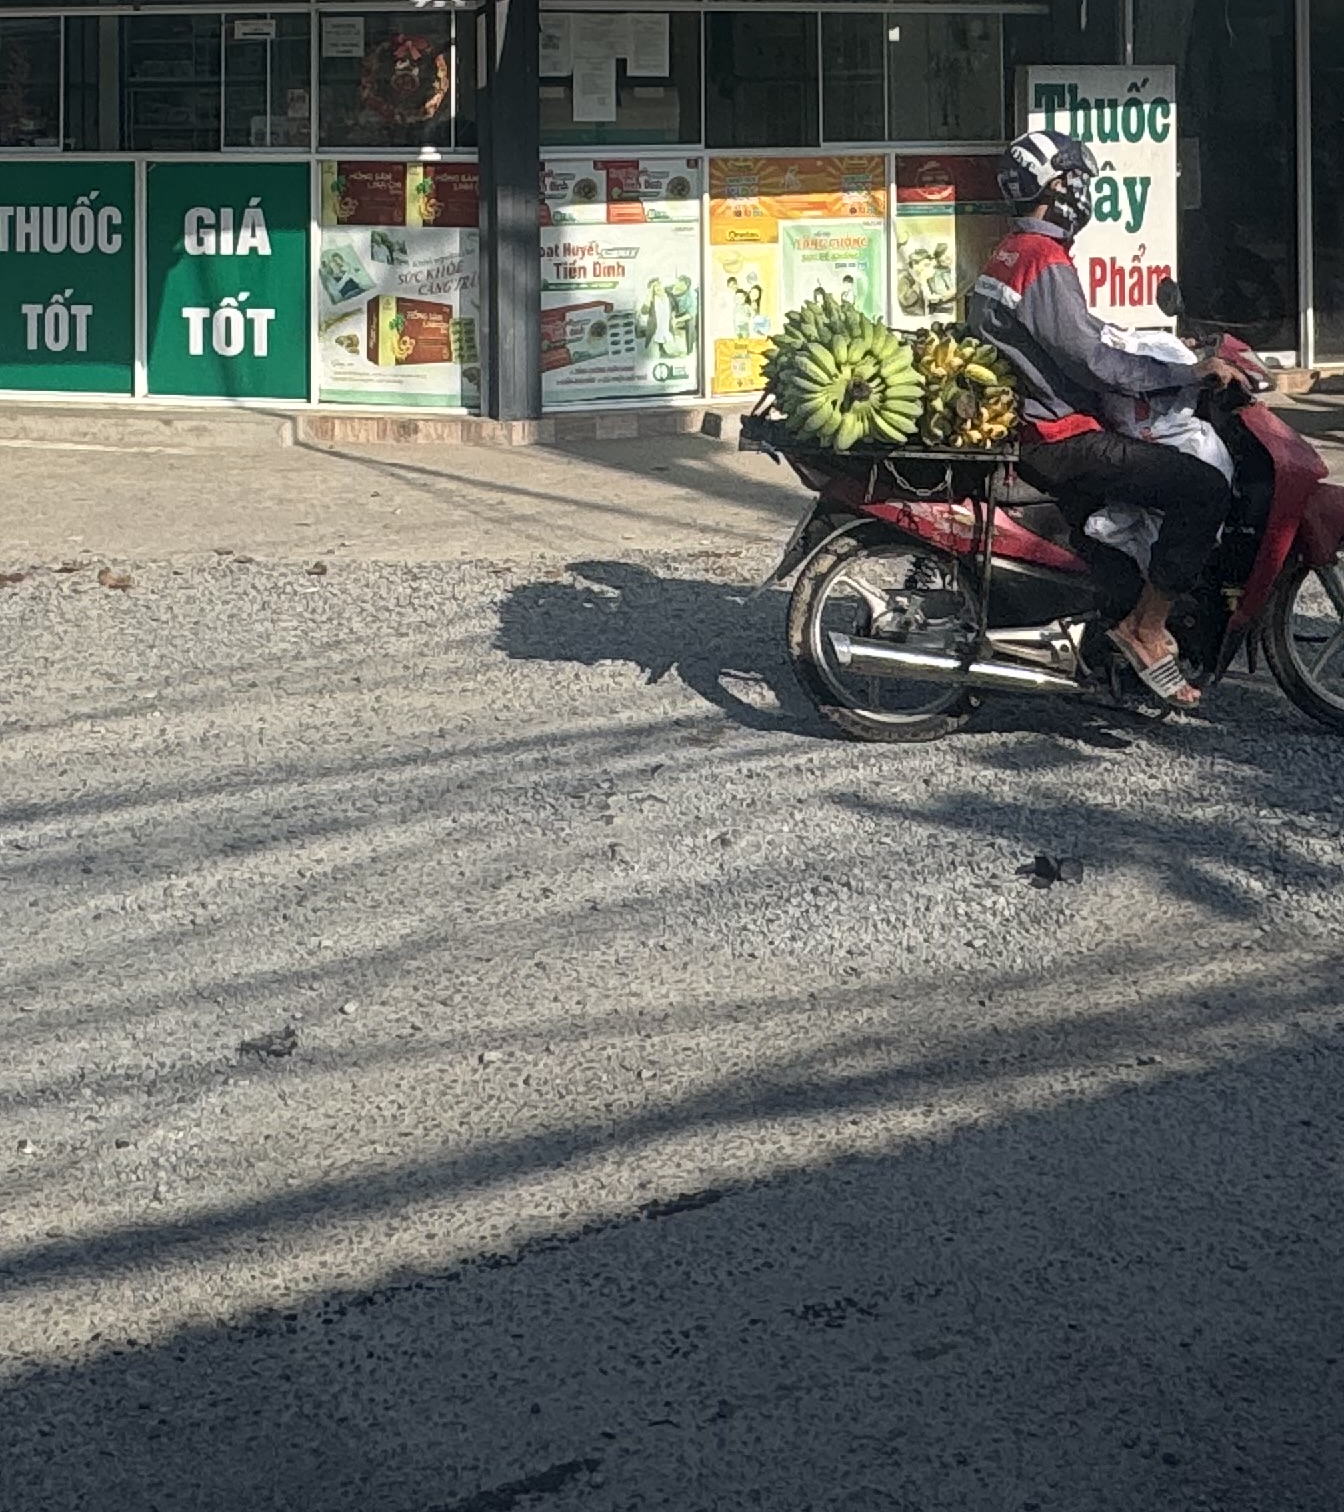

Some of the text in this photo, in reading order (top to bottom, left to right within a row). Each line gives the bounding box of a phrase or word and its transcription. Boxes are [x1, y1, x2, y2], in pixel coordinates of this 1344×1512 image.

[1034, 77, 1171, 144] Thuốc
[183, 196, 272, 256] GIÁ
[1093, 160, 1152, 234] ây
[1088, 243, 1172, 308] Phẩm
[21, 289, 94, 352] TỐT
[182, 291, 276, 357] TỐT
